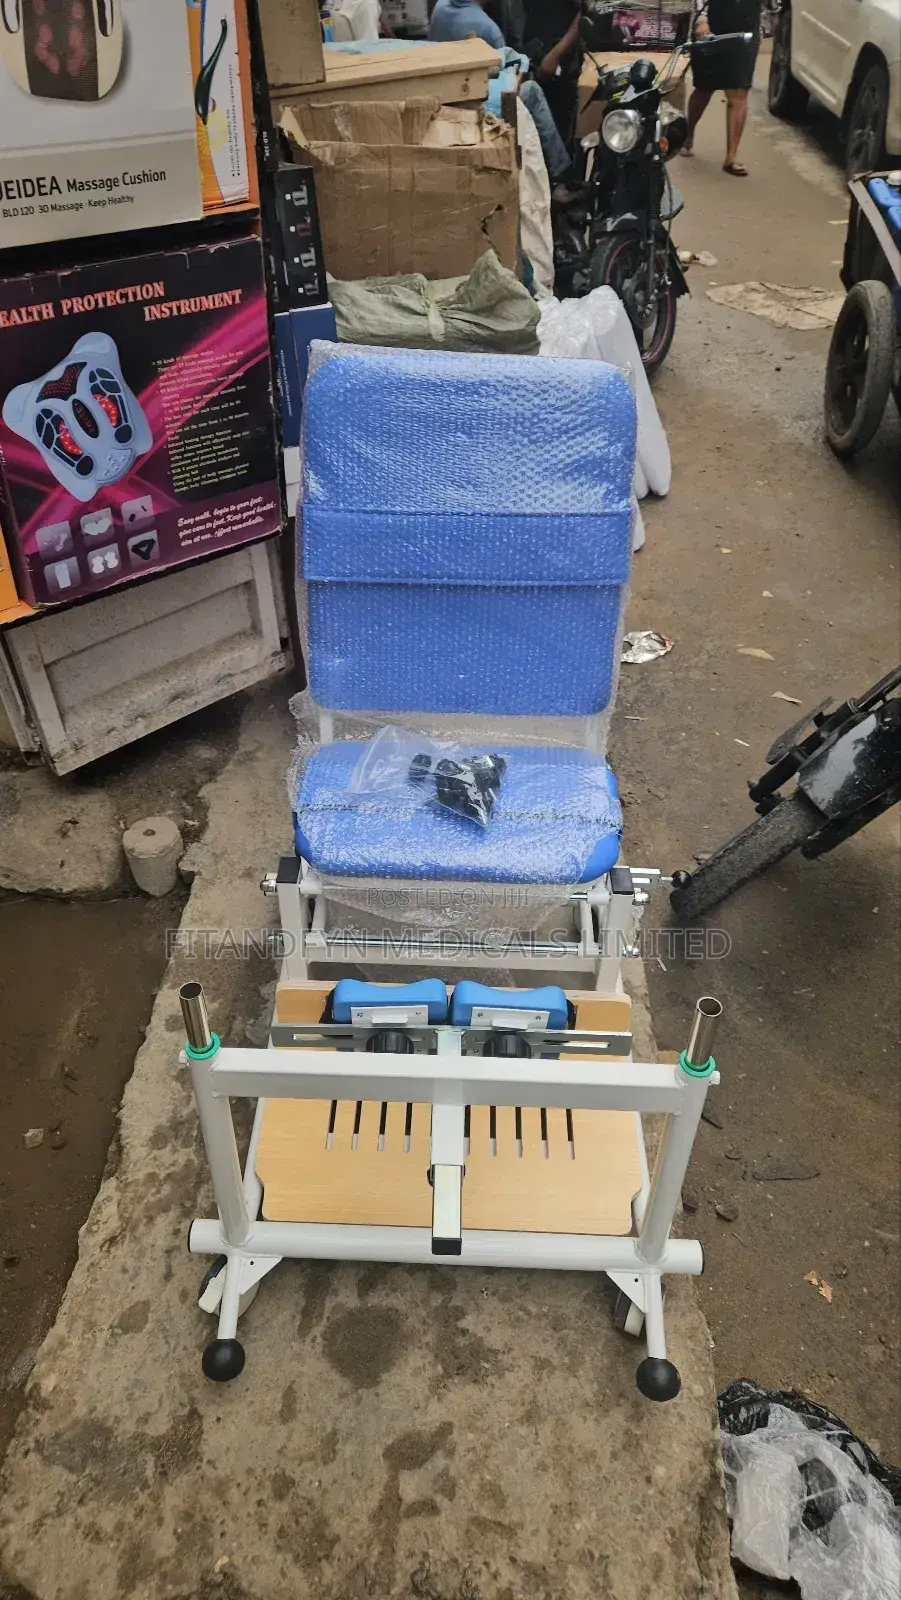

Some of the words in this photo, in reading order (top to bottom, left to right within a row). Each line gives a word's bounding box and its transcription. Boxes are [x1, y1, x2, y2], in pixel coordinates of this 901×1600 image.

[66, 178, 120, 192] Massage
[122, 169, 167, 186] Cushion
[2, 208, 19, 218] BLD
[20, 206, 34, 216] 120
[38, 204, 49, 214] 3D
[51, 201, 84, 212] Massage
[88, 198, 107, 208] Keep
[108, 195, 135, 206] Healthy
[60, 281, 166, 316] PROTECTION
[143, 288, 243, 322] INSTRUMENT
[177, 518, 194, 527] Easy
[213, 507, 229, 516] begin
[237, 501, 249, 510] your
[192, 525, 206, 533] care
[226, 513, 242, 522] Keep
[242, 508, 256, 519] good
